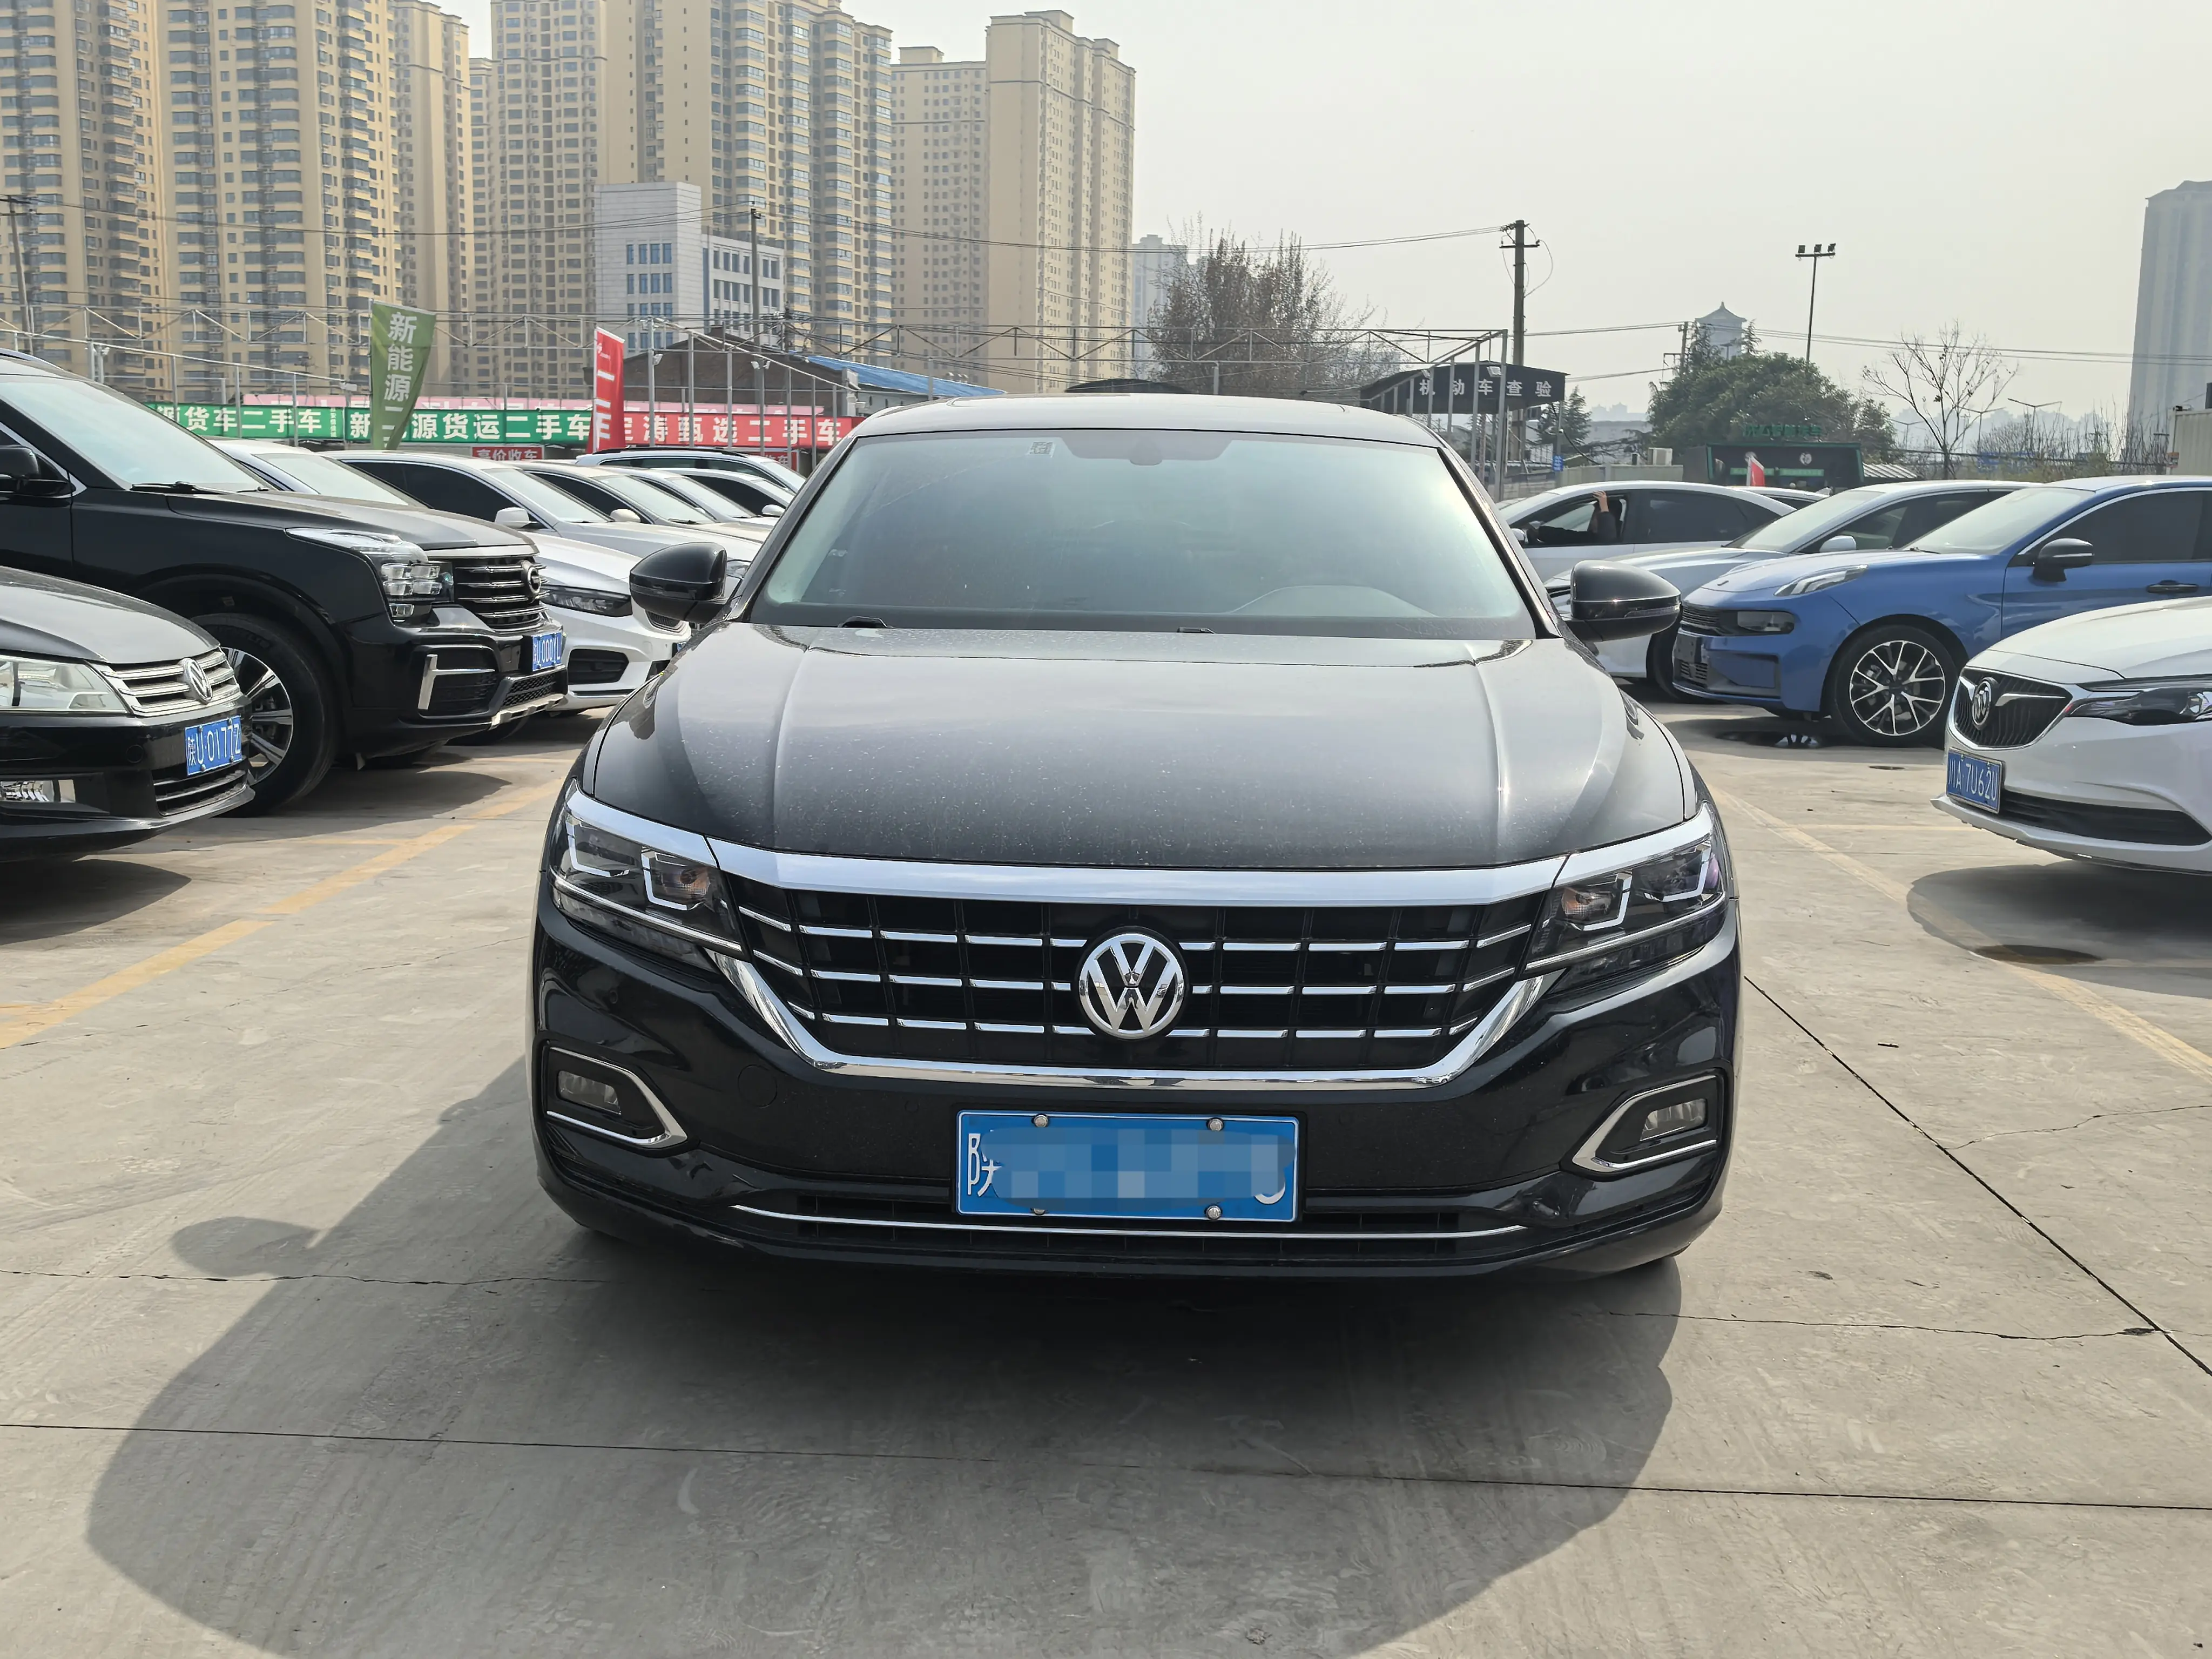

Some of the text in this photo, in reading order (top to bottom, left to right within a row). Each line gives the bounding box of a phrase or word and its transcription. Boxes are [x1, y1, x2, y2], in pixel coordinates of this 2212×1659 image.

[1419, 379, 1552, 397] 机动车查验
[350, 412, 591, 441] 新源货运二手车
